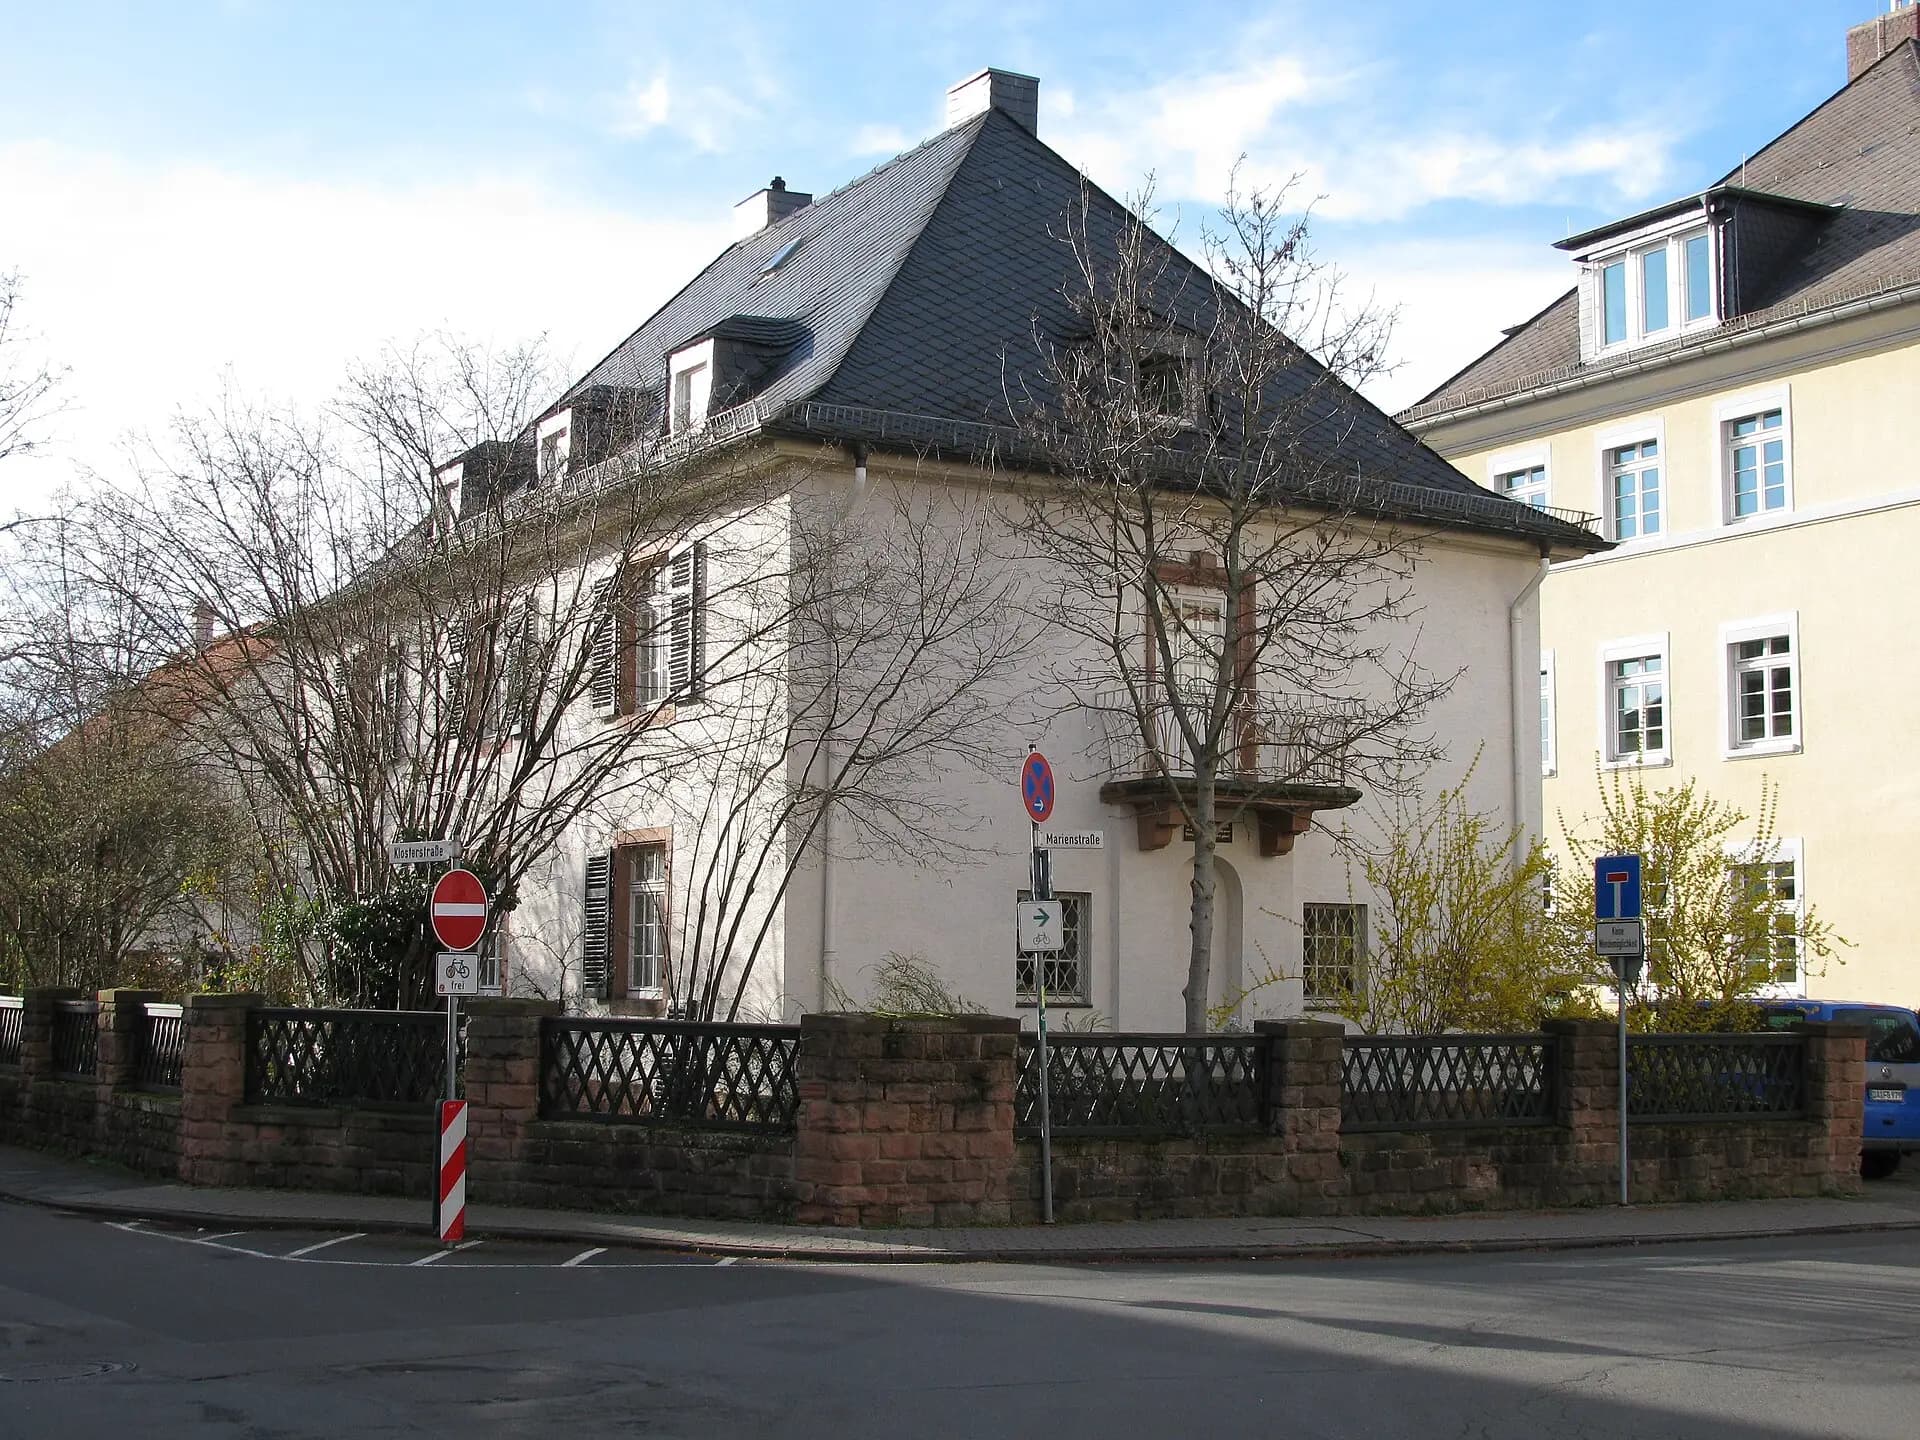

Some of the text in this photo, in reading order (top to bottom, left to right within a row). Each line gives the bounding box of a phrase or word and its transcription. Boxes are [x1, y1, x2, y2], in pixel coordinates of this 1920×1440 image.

[1046, 833, 1100, 845] Marienstraße
[394, 845, 444, 858] Klosterstraße
[451, 980, 465, 990] frei
